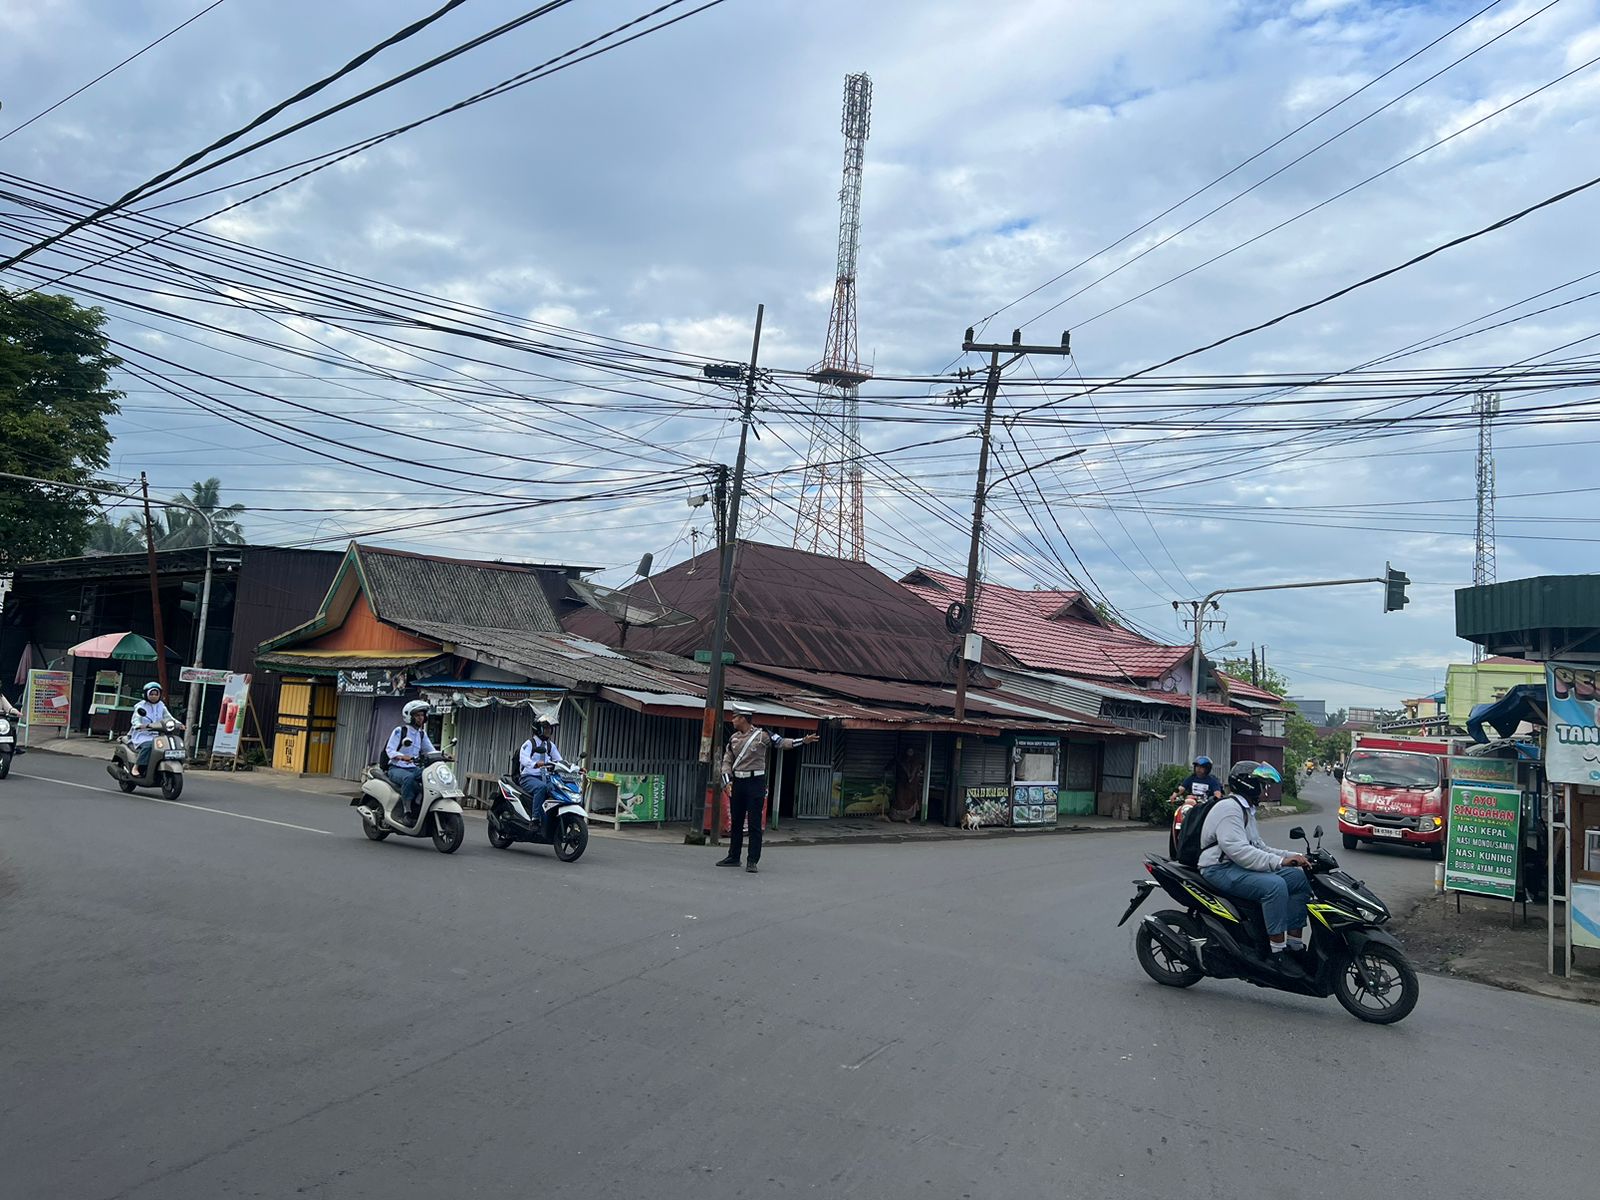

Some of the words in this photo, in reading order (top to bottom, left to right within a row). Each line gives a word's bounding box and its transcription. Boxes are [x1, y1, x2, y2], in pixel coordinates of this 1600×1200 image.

[1554, 667, 1600, 701] PE
[1472, 795, 1497, 807] AYO!
[1454, 804, 1515, 822] SINGGAHAN
[1457, 824, 1477, 834] NASI
[1480, 827, 1507, 838] KEPAL
[1456, 836, 1470, 844] NASI
[1455, 848, 1476, 858] NASI
[1479, 851, 1513, 864] KUNING
[1455, 860, 1475, 870] BUBUR
[1477, 864, 1494, 873] AYAM
[1496, 868, 1512, 876] ARAB
